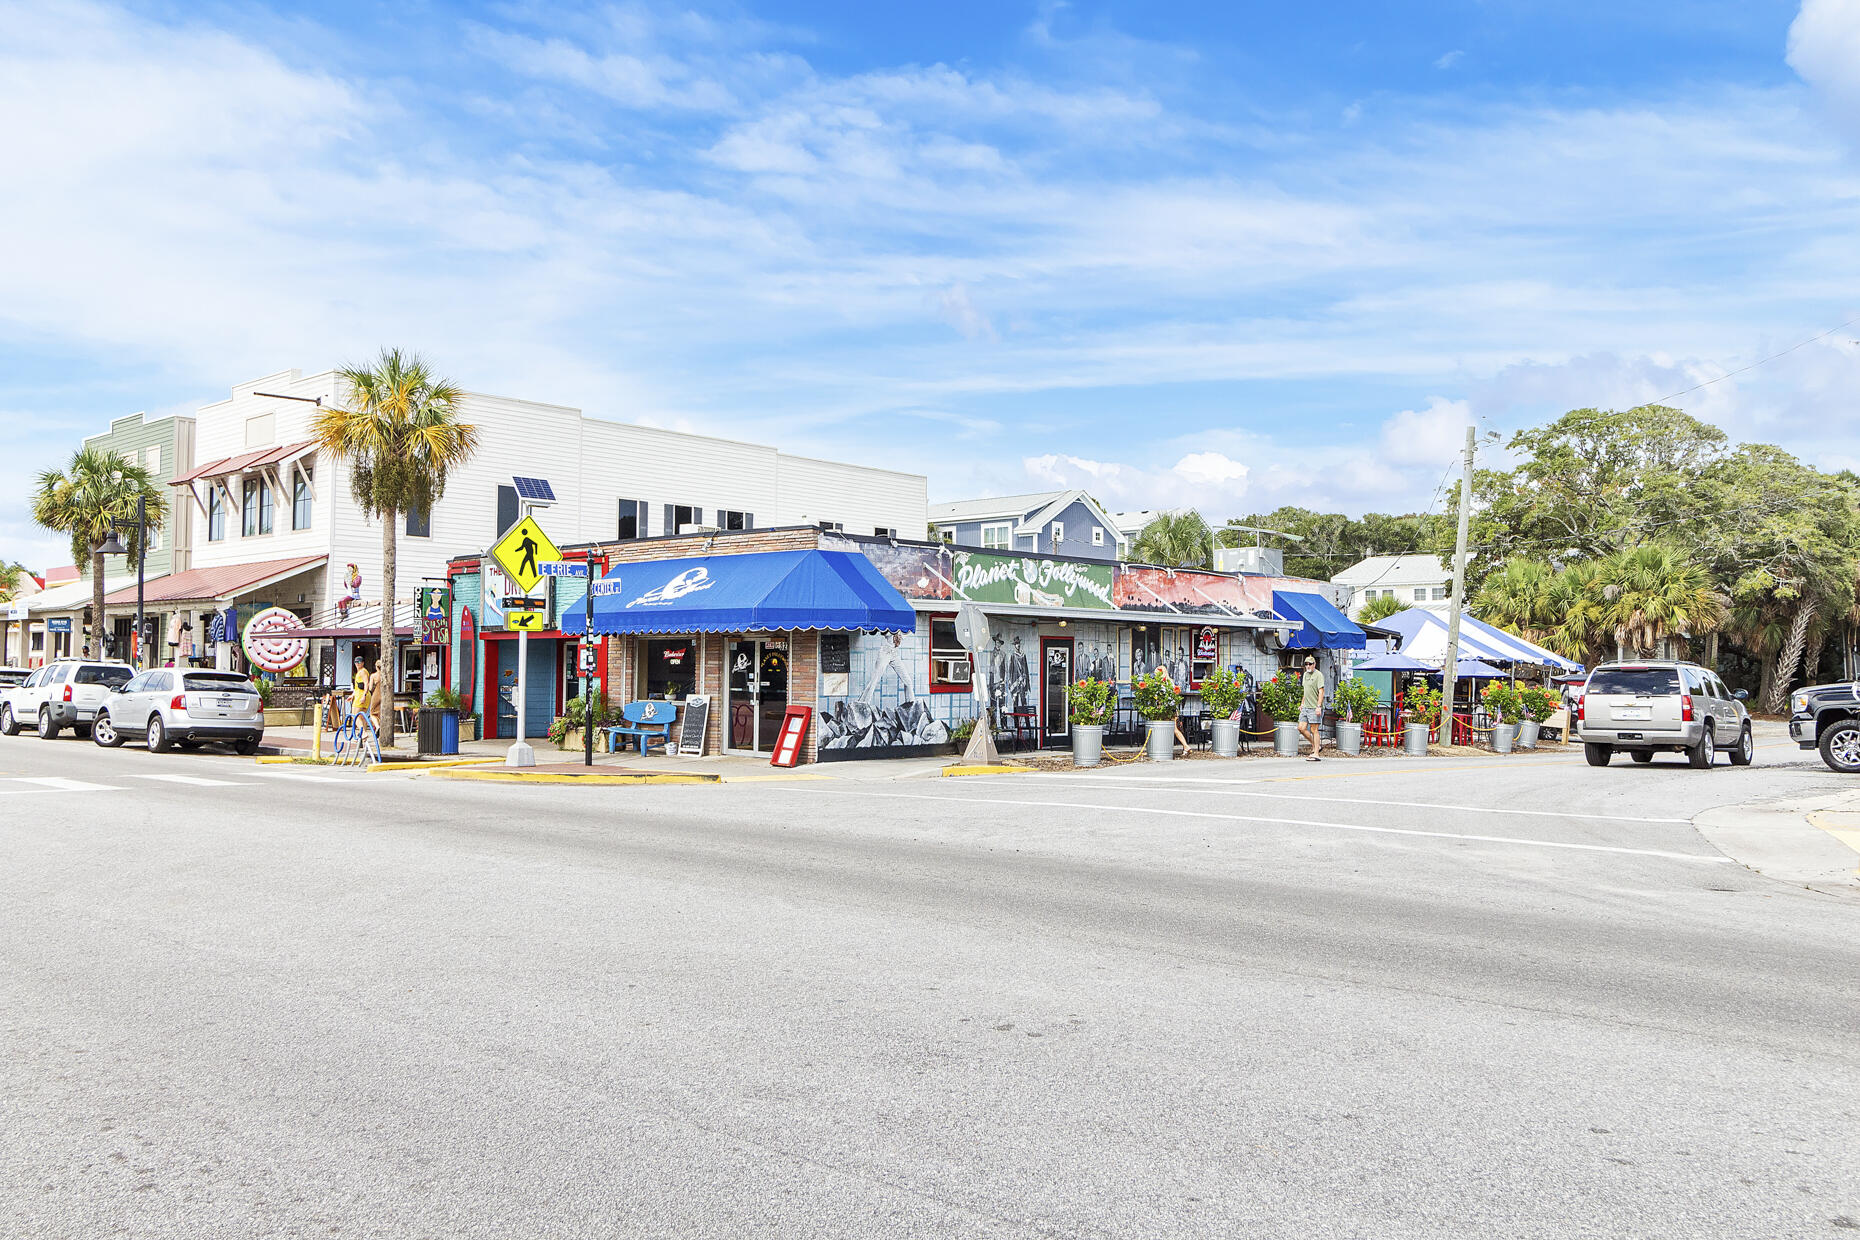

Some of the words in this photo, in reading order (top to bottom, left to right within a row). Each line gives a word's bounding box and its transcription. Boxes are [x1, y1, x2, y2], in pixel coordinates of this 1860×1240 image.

[489, 567, 502, 576] THE
[551, 563, 571, 576] ERIE
[957, 560, 1020, 593] Planet
[1039, 560, 1111, 600] Follywood
[414, 587, 422, 618] OPEN
[422, 618, 448, 635] SUSHI
[432, 628, 449, 643] LISA
